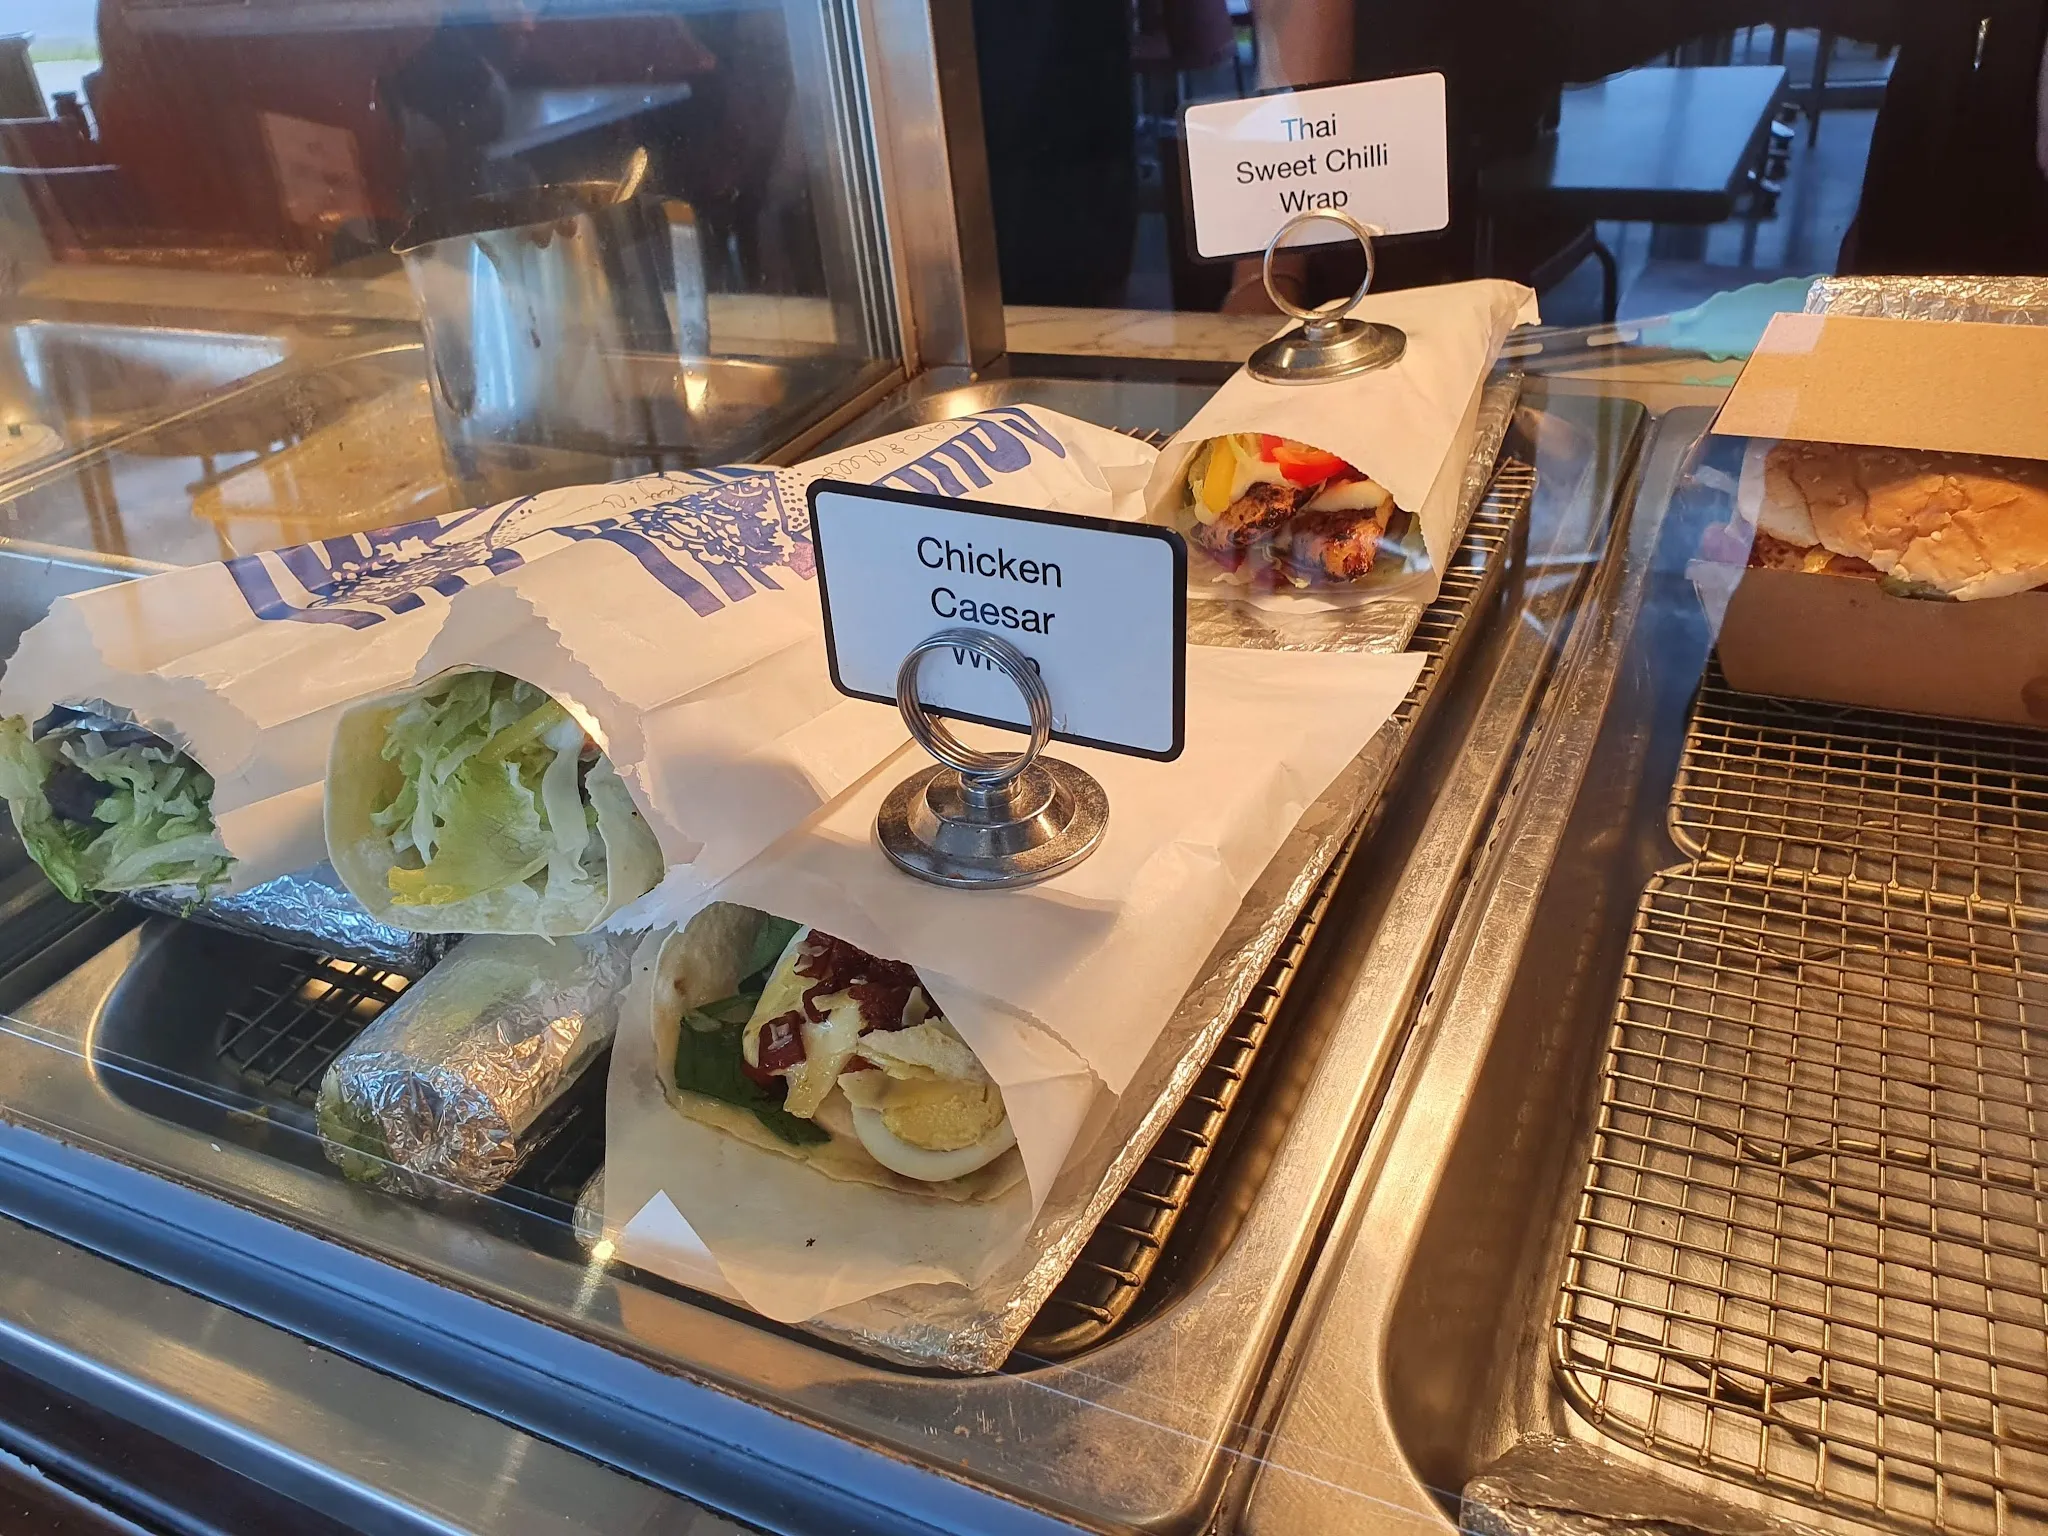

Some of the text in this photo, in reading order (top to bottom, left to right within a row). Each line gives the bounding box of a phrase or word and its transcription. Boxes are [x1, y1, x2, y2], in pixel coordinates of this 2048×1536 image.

[1280, 113, 1337, 142] Thai
[1236, 143, 1389, 184] Sweet Chilli
[1279, 188, 1349, 214] Wrap
[916, 535, 1063, 589] Chicken
[930, 586, 1056, 636] Caesar
